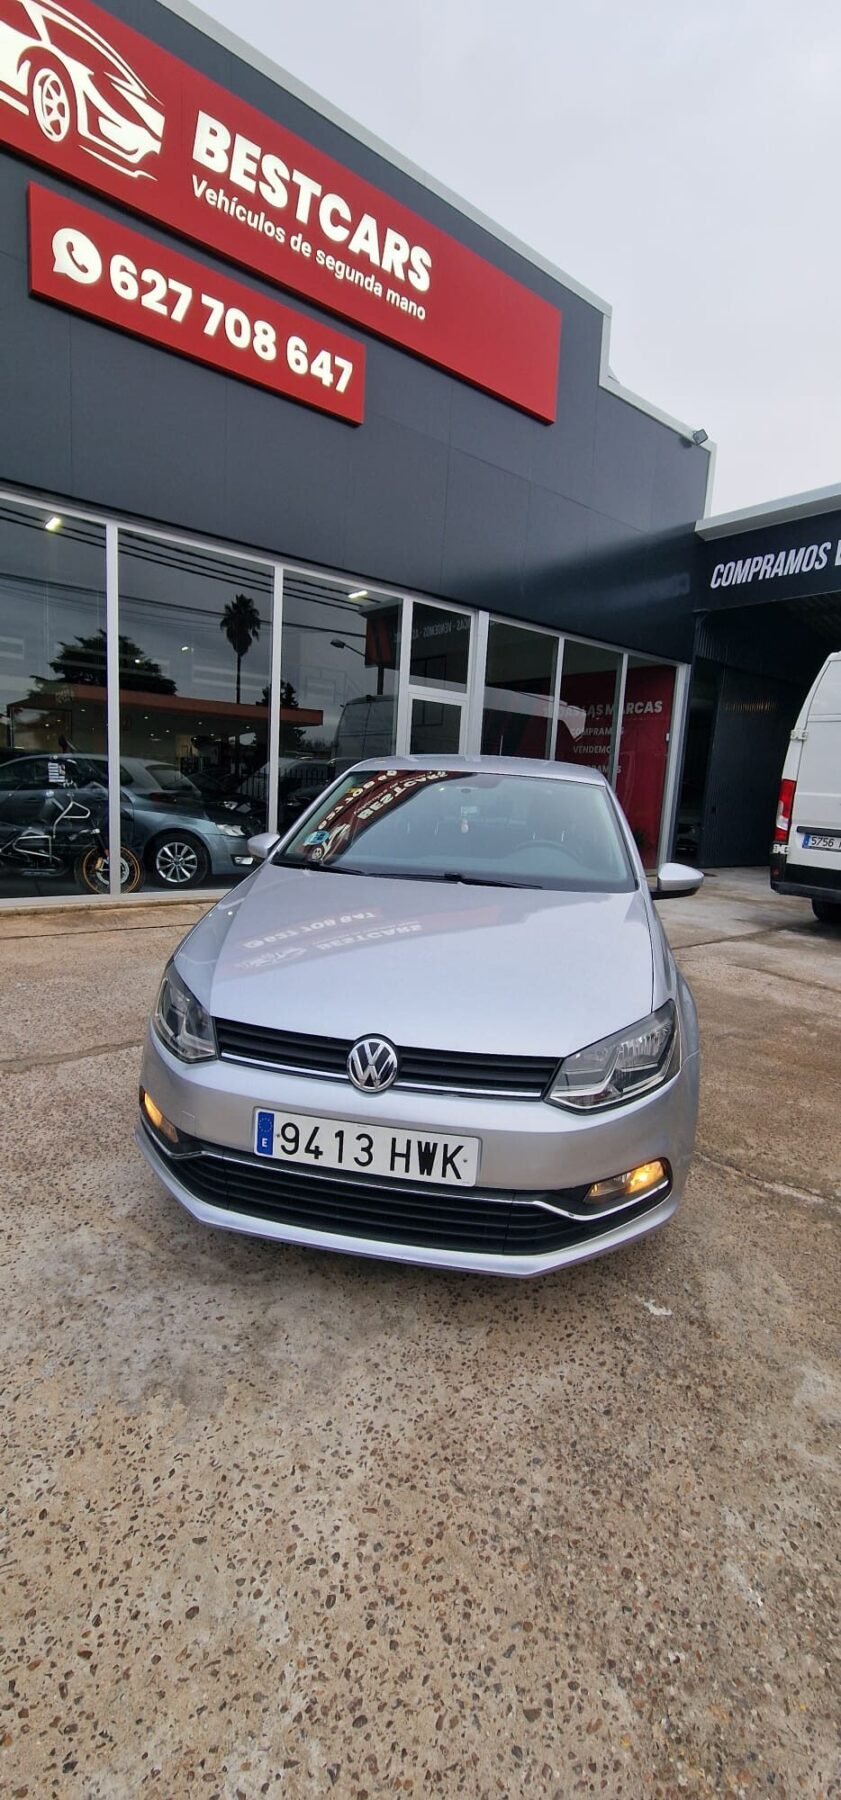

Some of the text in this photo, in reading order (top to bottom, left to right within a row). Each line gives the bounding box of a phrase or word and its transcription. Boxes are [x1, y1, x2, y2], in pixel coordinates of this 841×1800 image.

[192, 110, 432, 292] BESTCARS
[192, 174, 426, 320] Vehículos de segunda mano
[109, 254, 353, 393] 627 708 647
[710, 541, 832, 589] COMPRAMOS
[811, 836, 835, 848] 5756
[261, 1138, 268, 1148] E
[281, 1122, 464, 1180] 9413 HWK
